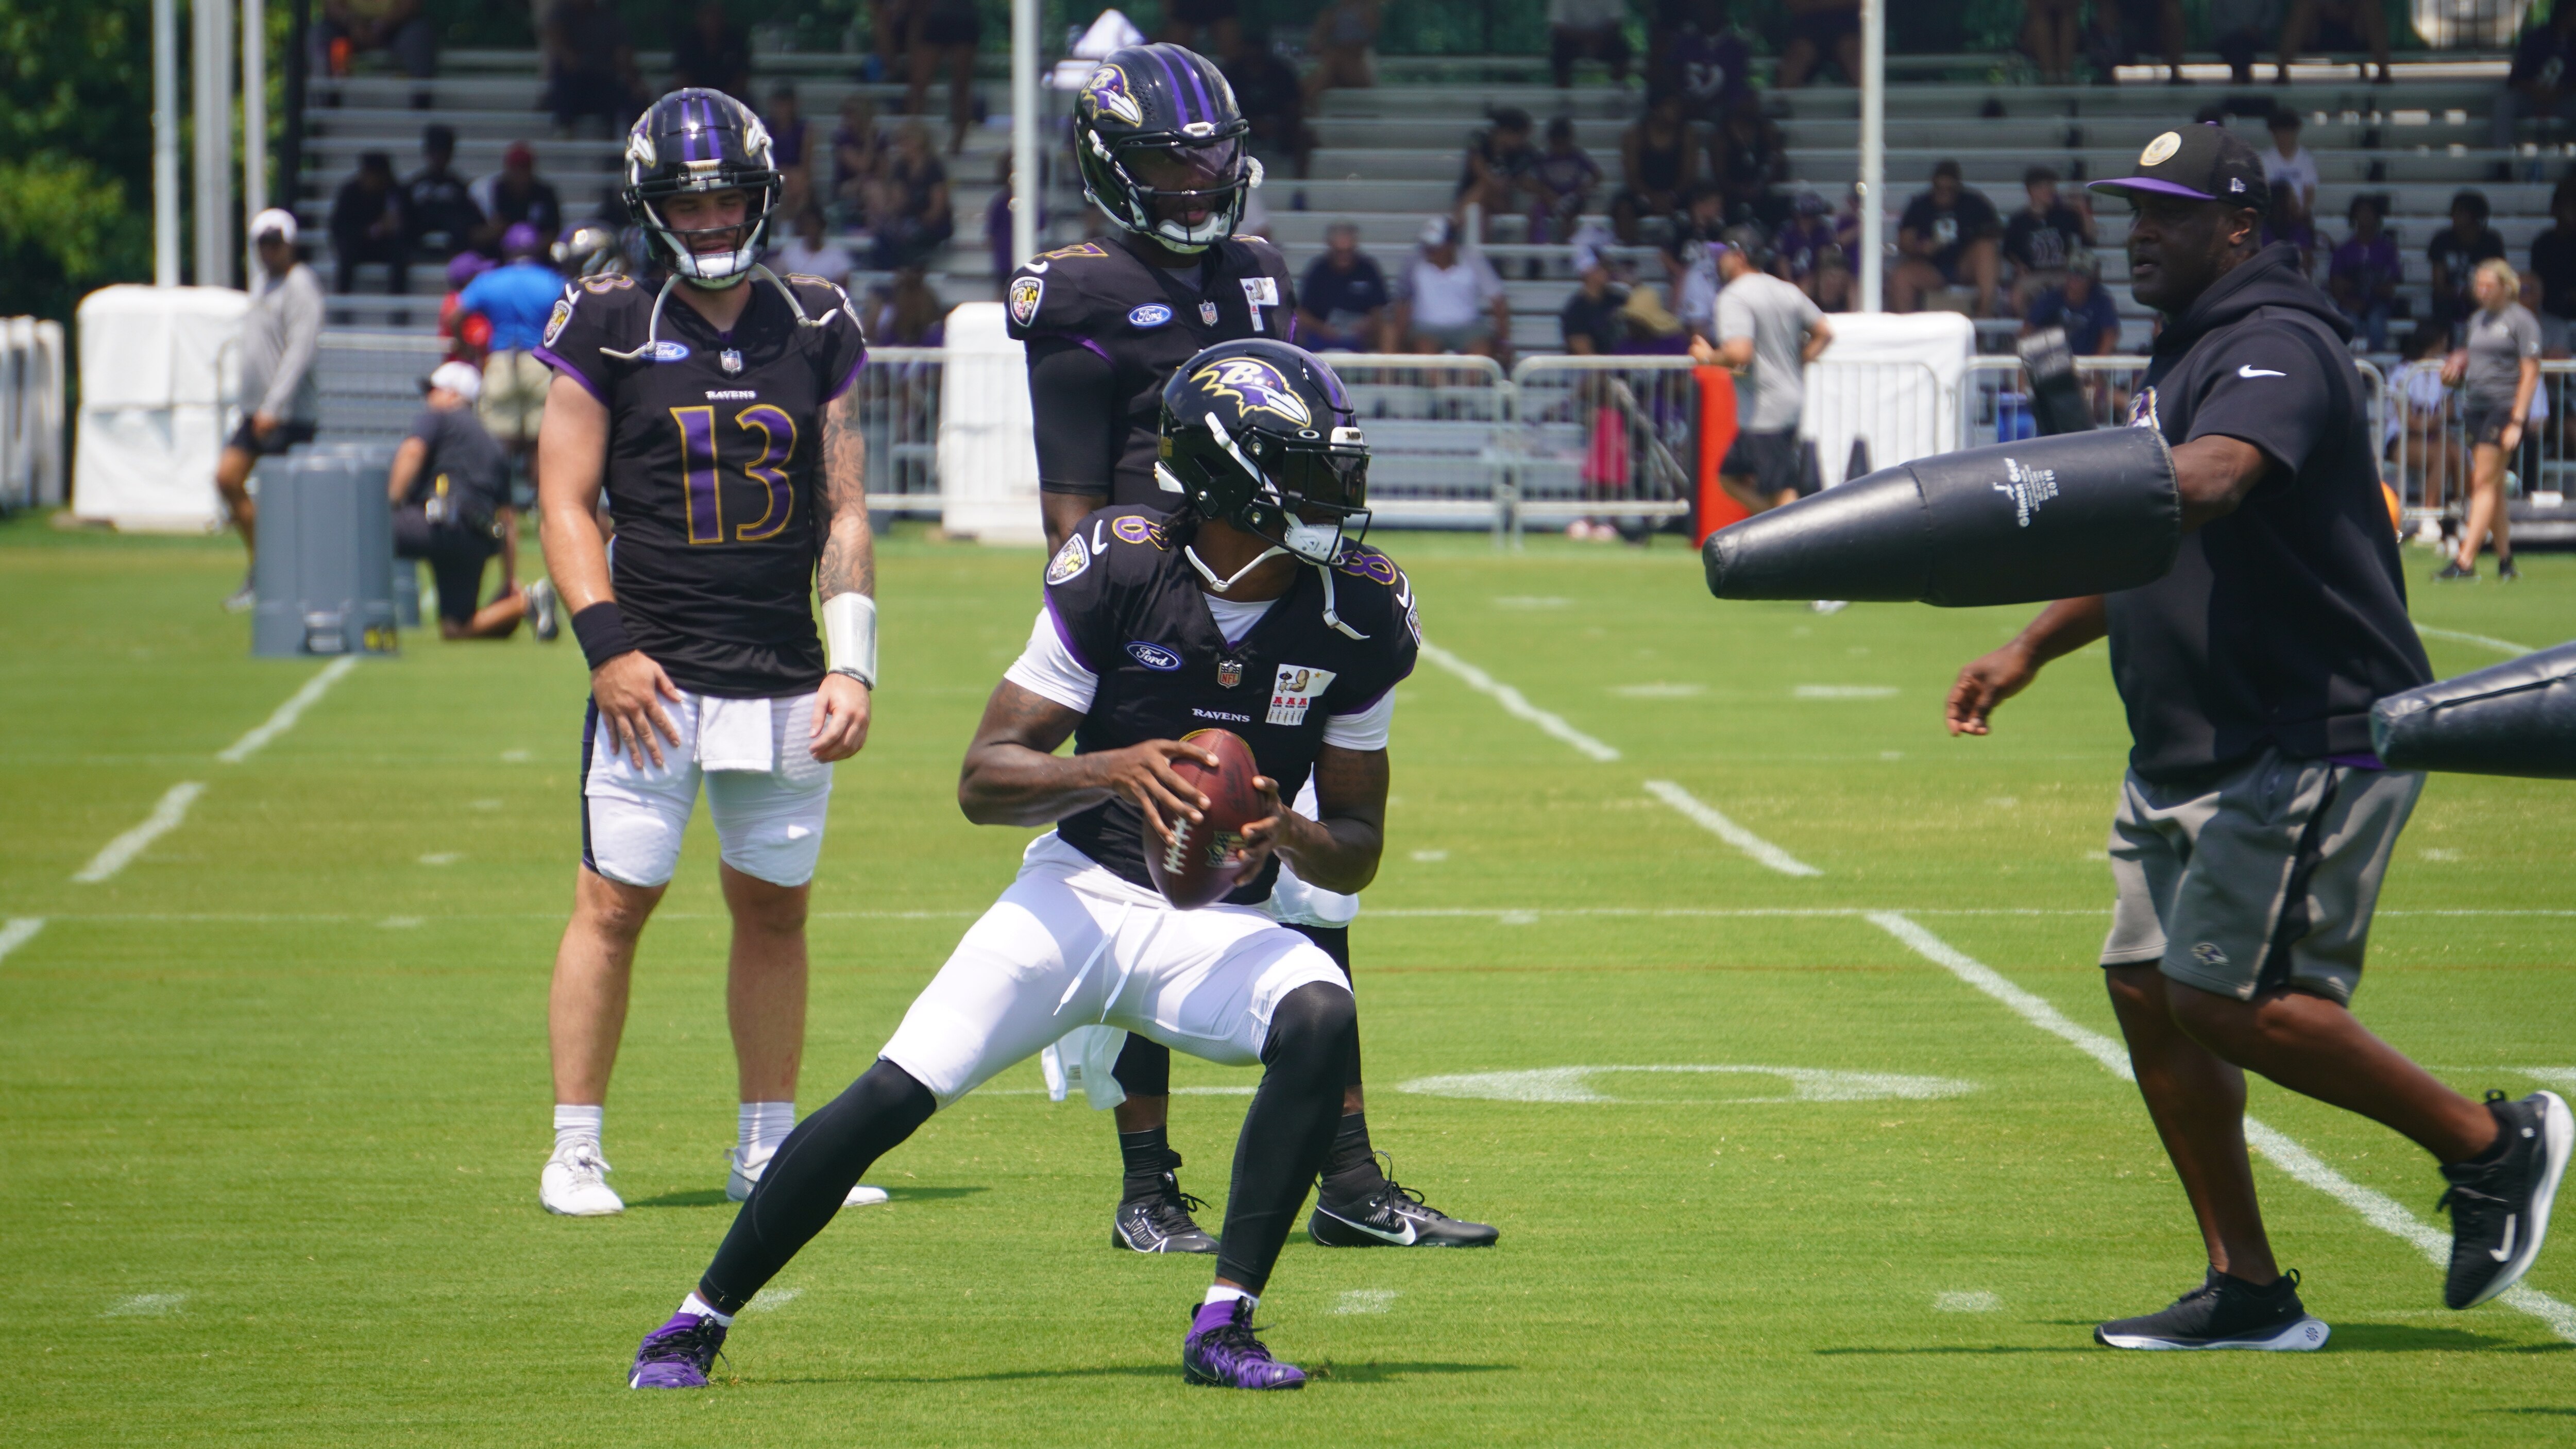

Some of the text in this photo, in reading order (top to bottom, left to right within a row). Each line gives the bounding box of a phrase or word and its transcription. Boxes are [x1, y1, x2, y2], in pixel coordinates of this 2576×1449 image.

[1137, 309, 1163, 322] Ford
[1204, 311, 1216, 322] NFL
[725, 357, 739, 369] NFL
[705, 390, 756, 400] RAVENS
[669, 404, 798, 544] 13
[1136, 646, 1168, 667] Ford
[1222, 673, 1238, 684] NFL
[1191, 708, 1251, 722] RAVENS
